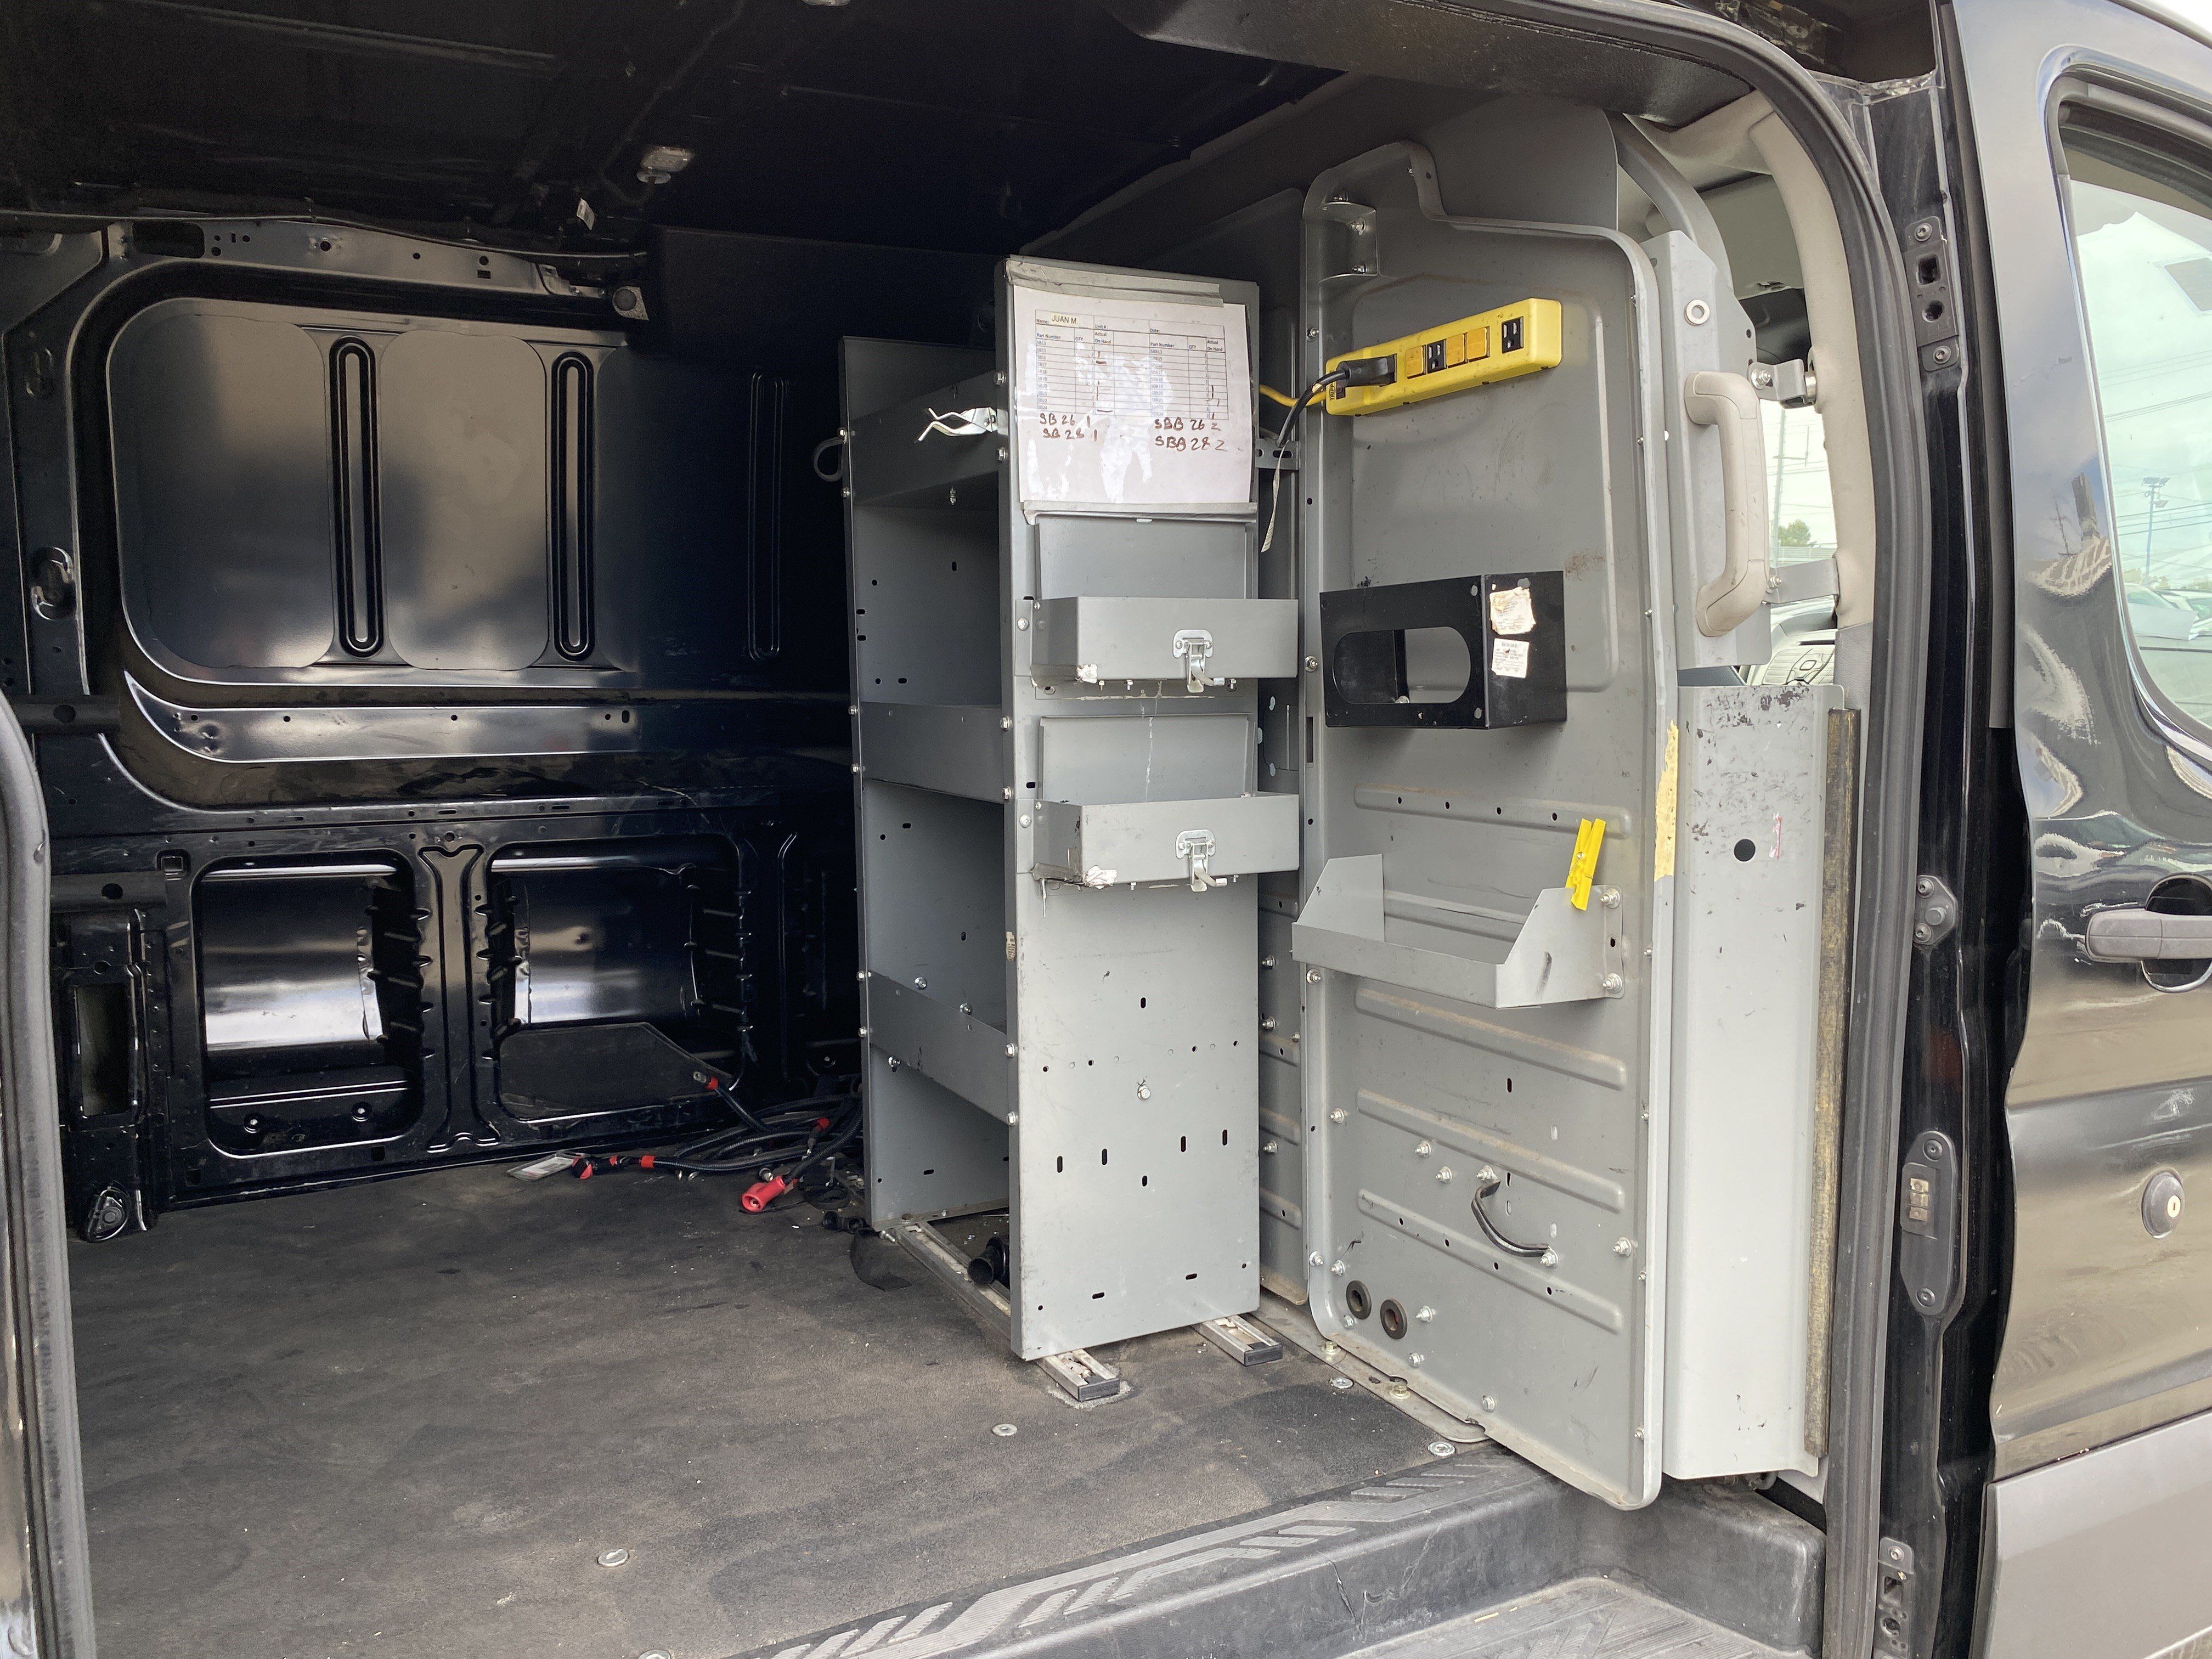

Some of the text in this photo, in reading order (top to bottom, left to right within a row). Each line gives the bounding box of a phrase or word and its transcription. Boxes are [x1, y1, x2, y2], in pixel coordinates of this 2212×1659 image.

[1052, 314, 1069, 323] JUAN
[1062, 414, 1075, 426] 26
[1154, 416, 1184, 431] SBB
[1190, 419, 1205, 431] 26
[1155, 435, 1186, 452] SBB
